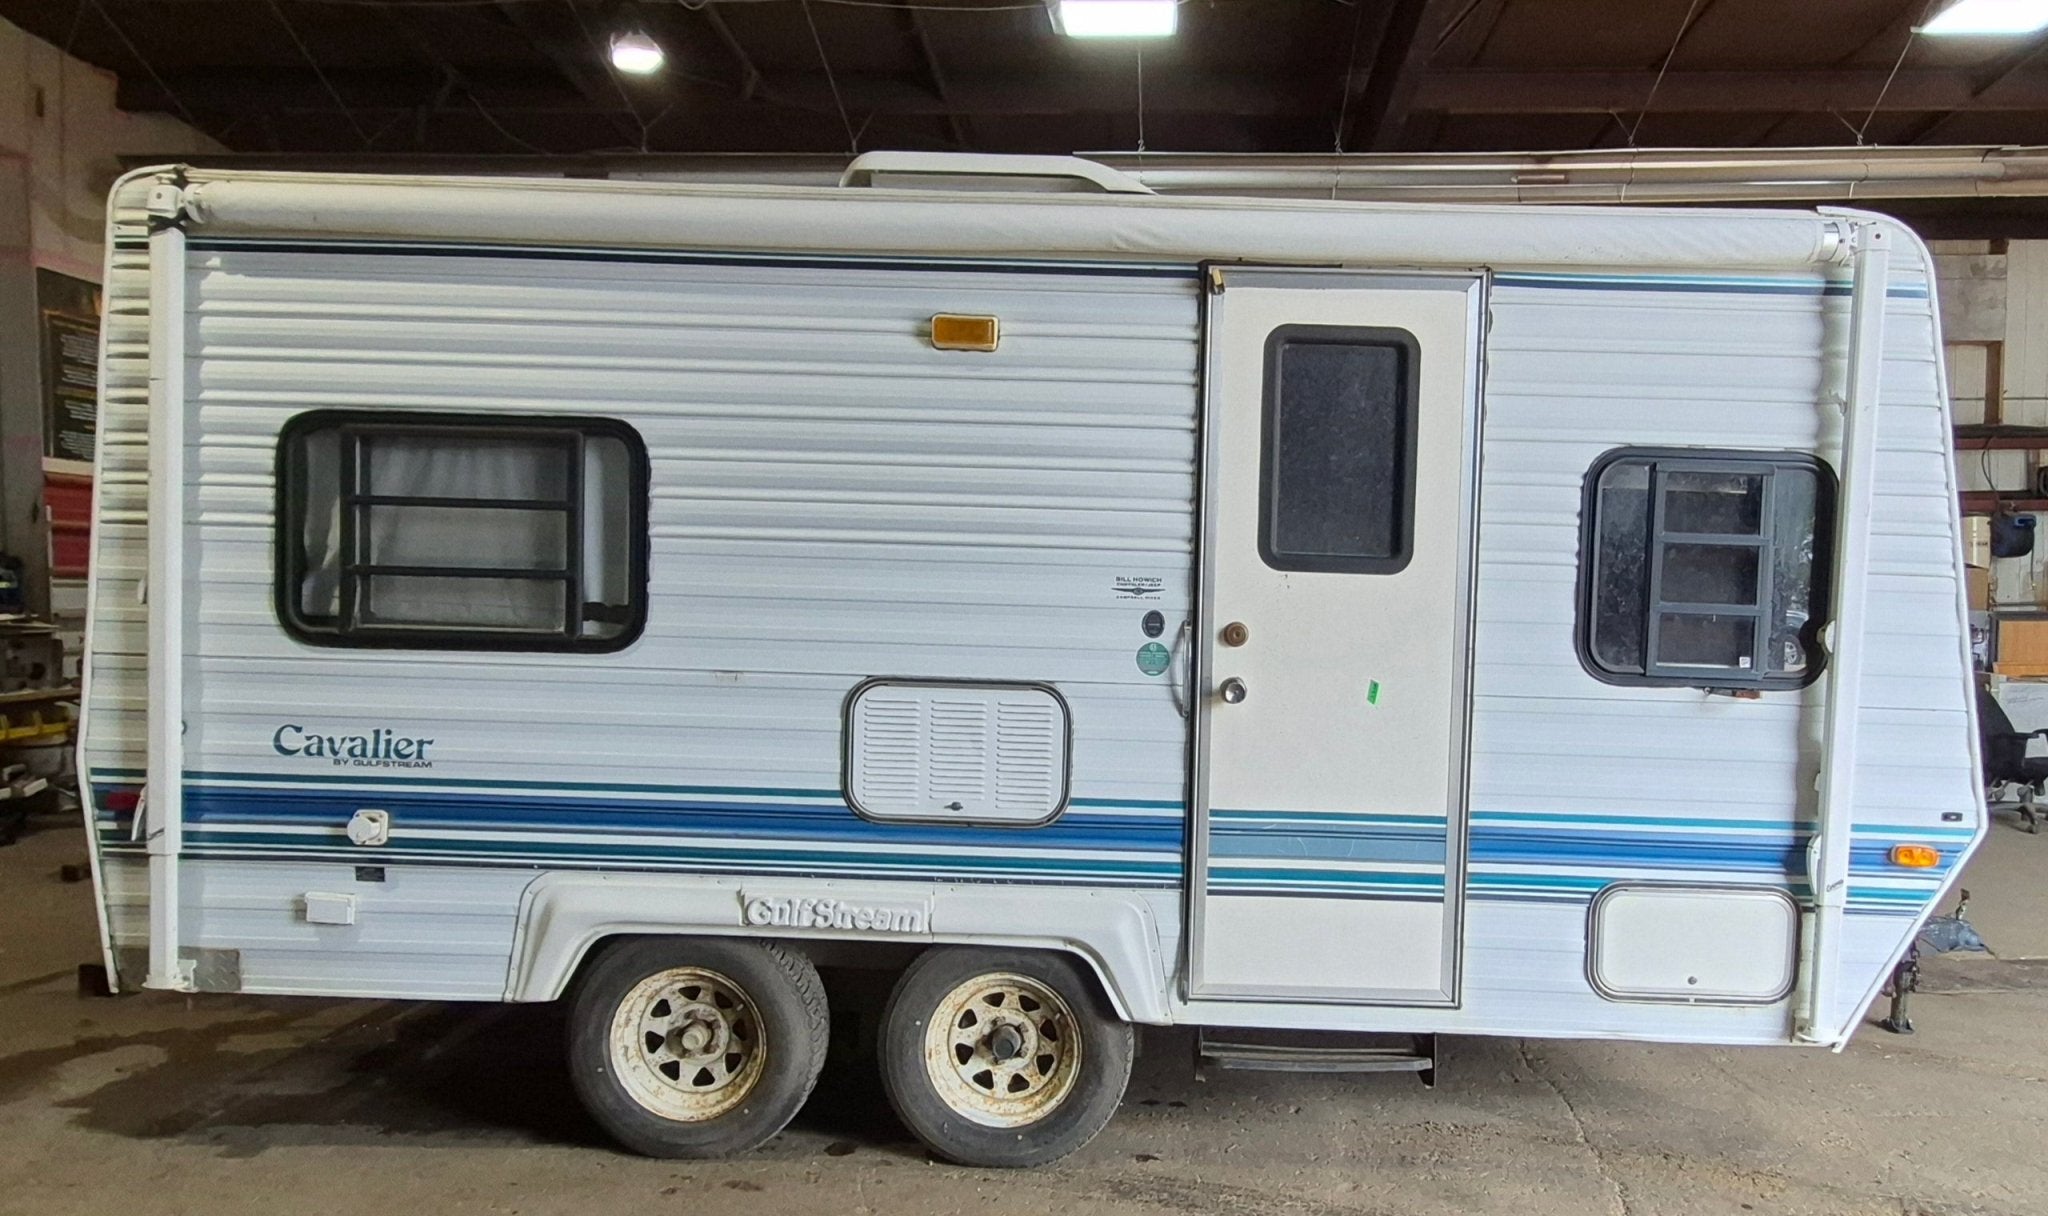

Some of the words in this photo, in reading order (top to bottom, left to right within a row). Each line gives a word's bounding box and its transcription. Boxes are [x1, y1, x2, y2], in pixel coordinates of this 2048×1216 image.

[273, 724, 434, 759] Cavalier
[333, 758, 349, 766] BY
[353, 759, 433, 769] GULFSTREAM
